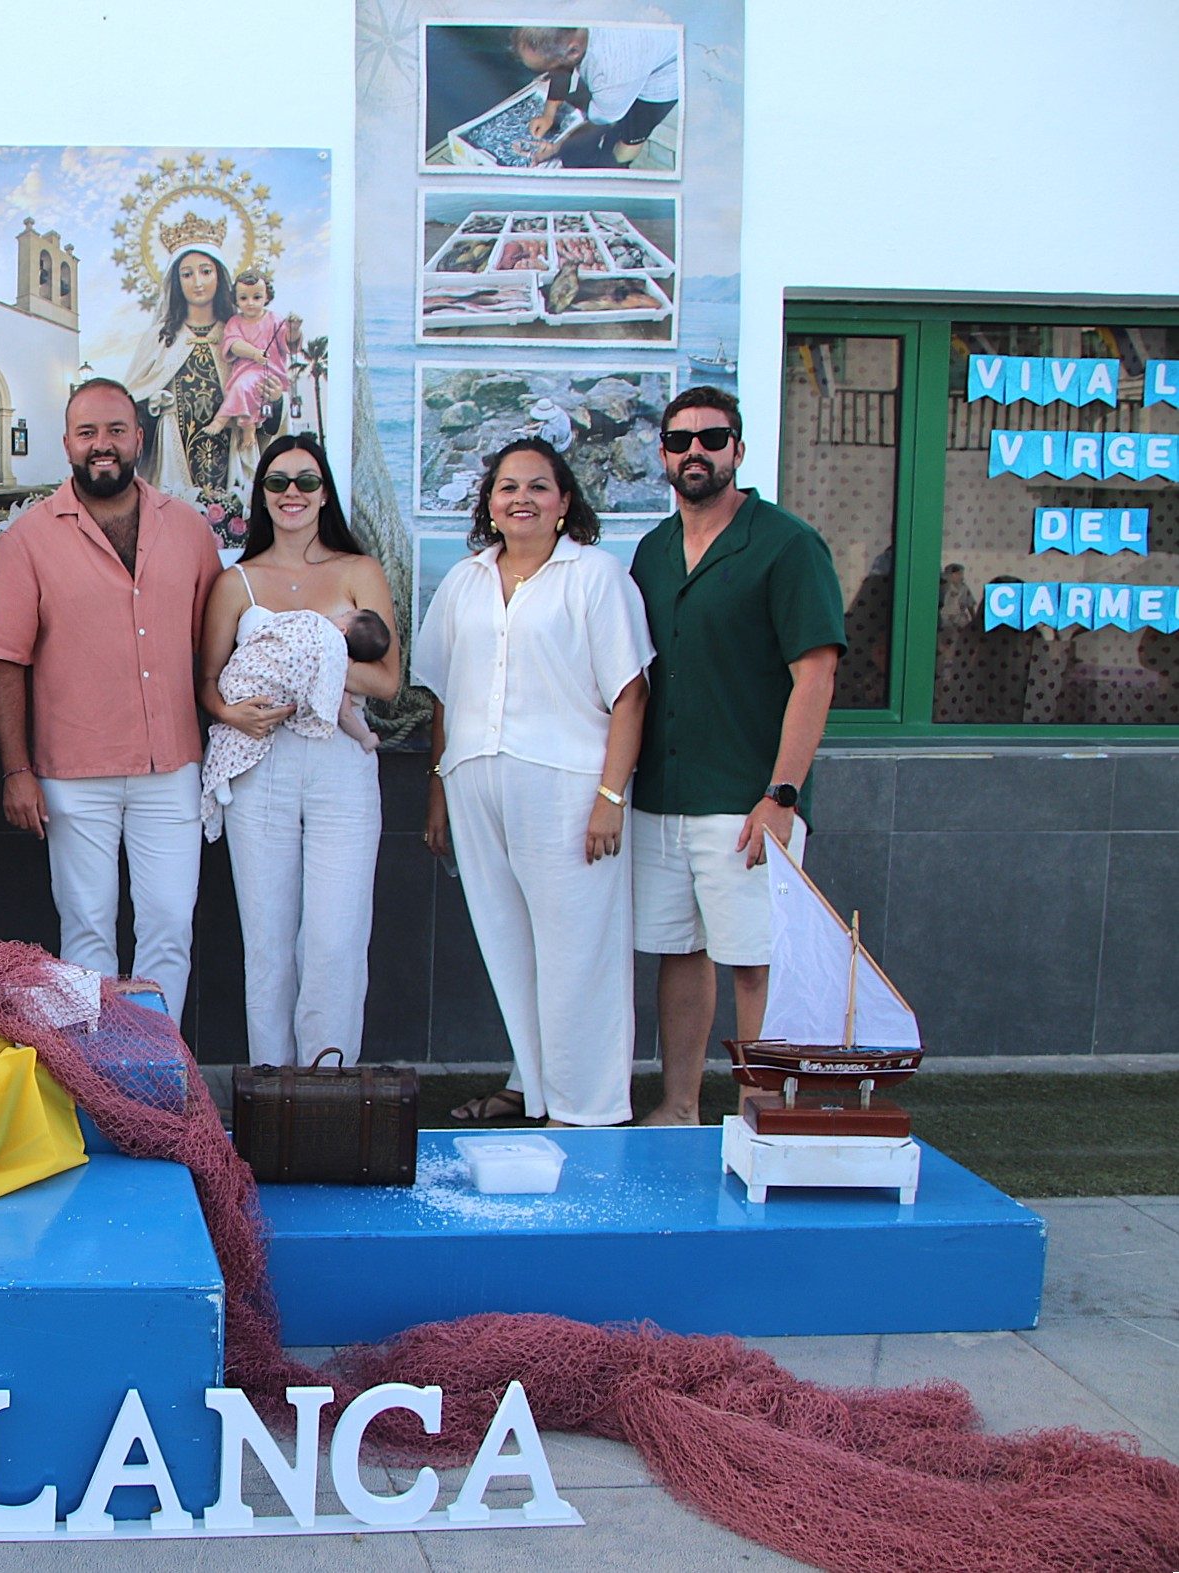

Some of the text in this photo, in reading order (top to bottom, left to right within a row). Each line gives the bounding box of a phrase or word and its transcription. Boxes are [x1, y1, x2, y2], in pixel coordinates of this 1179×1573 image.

[976, 358, 1112, 395] VIVA
[1040, 510, 1142, 543] DEL
[989, 587, 1179, 621] CARME
